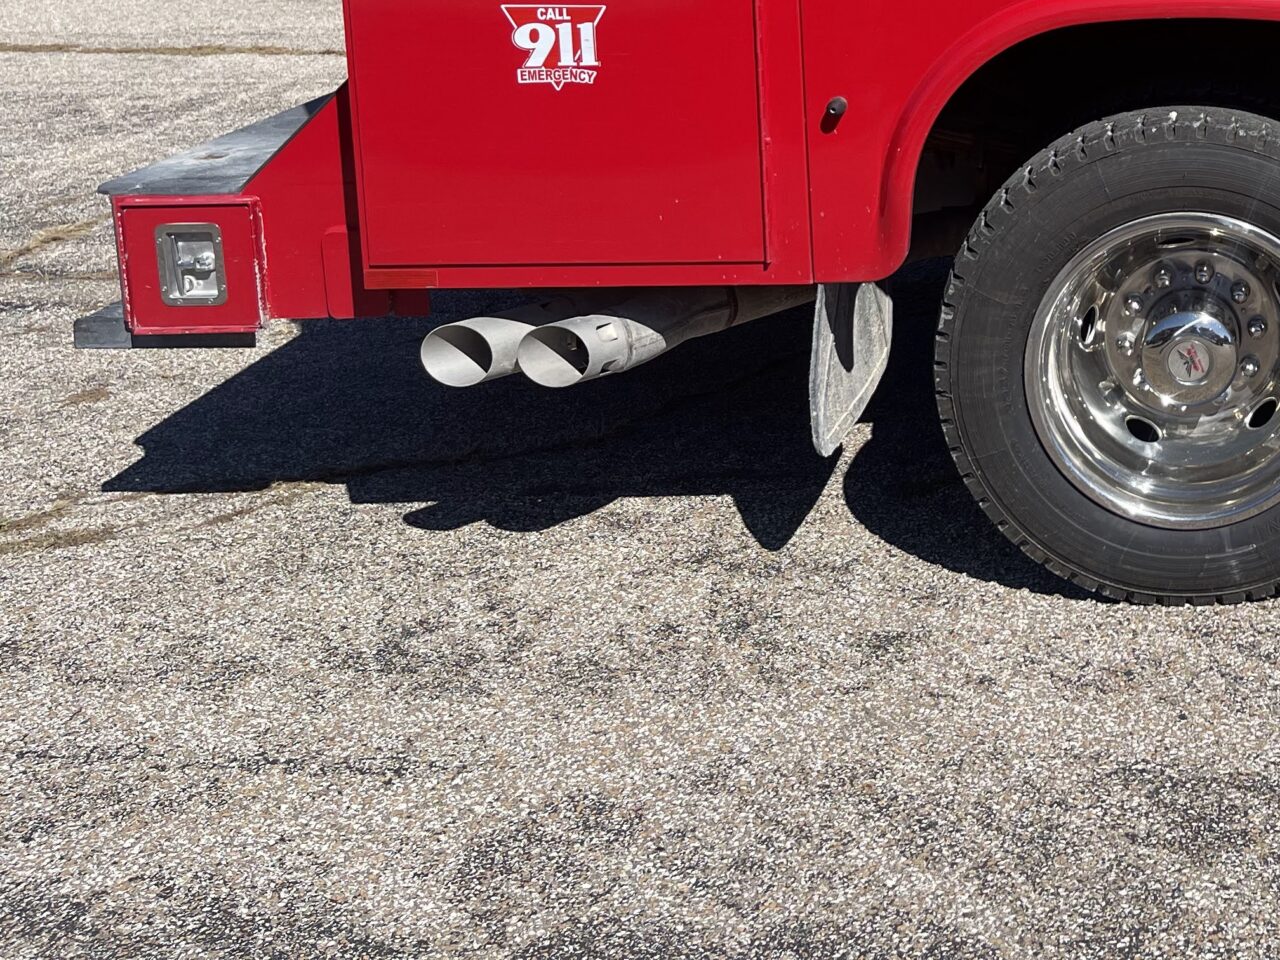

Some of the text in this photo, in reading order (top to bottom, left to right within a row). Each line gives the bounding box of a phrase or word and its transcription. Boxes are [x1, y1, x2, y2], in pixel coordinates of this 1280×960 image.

[537, 8, 571, 20] CALL
[513, 22, 599, 68] 911
[520, 69, 595, 83] EMERGENCY
